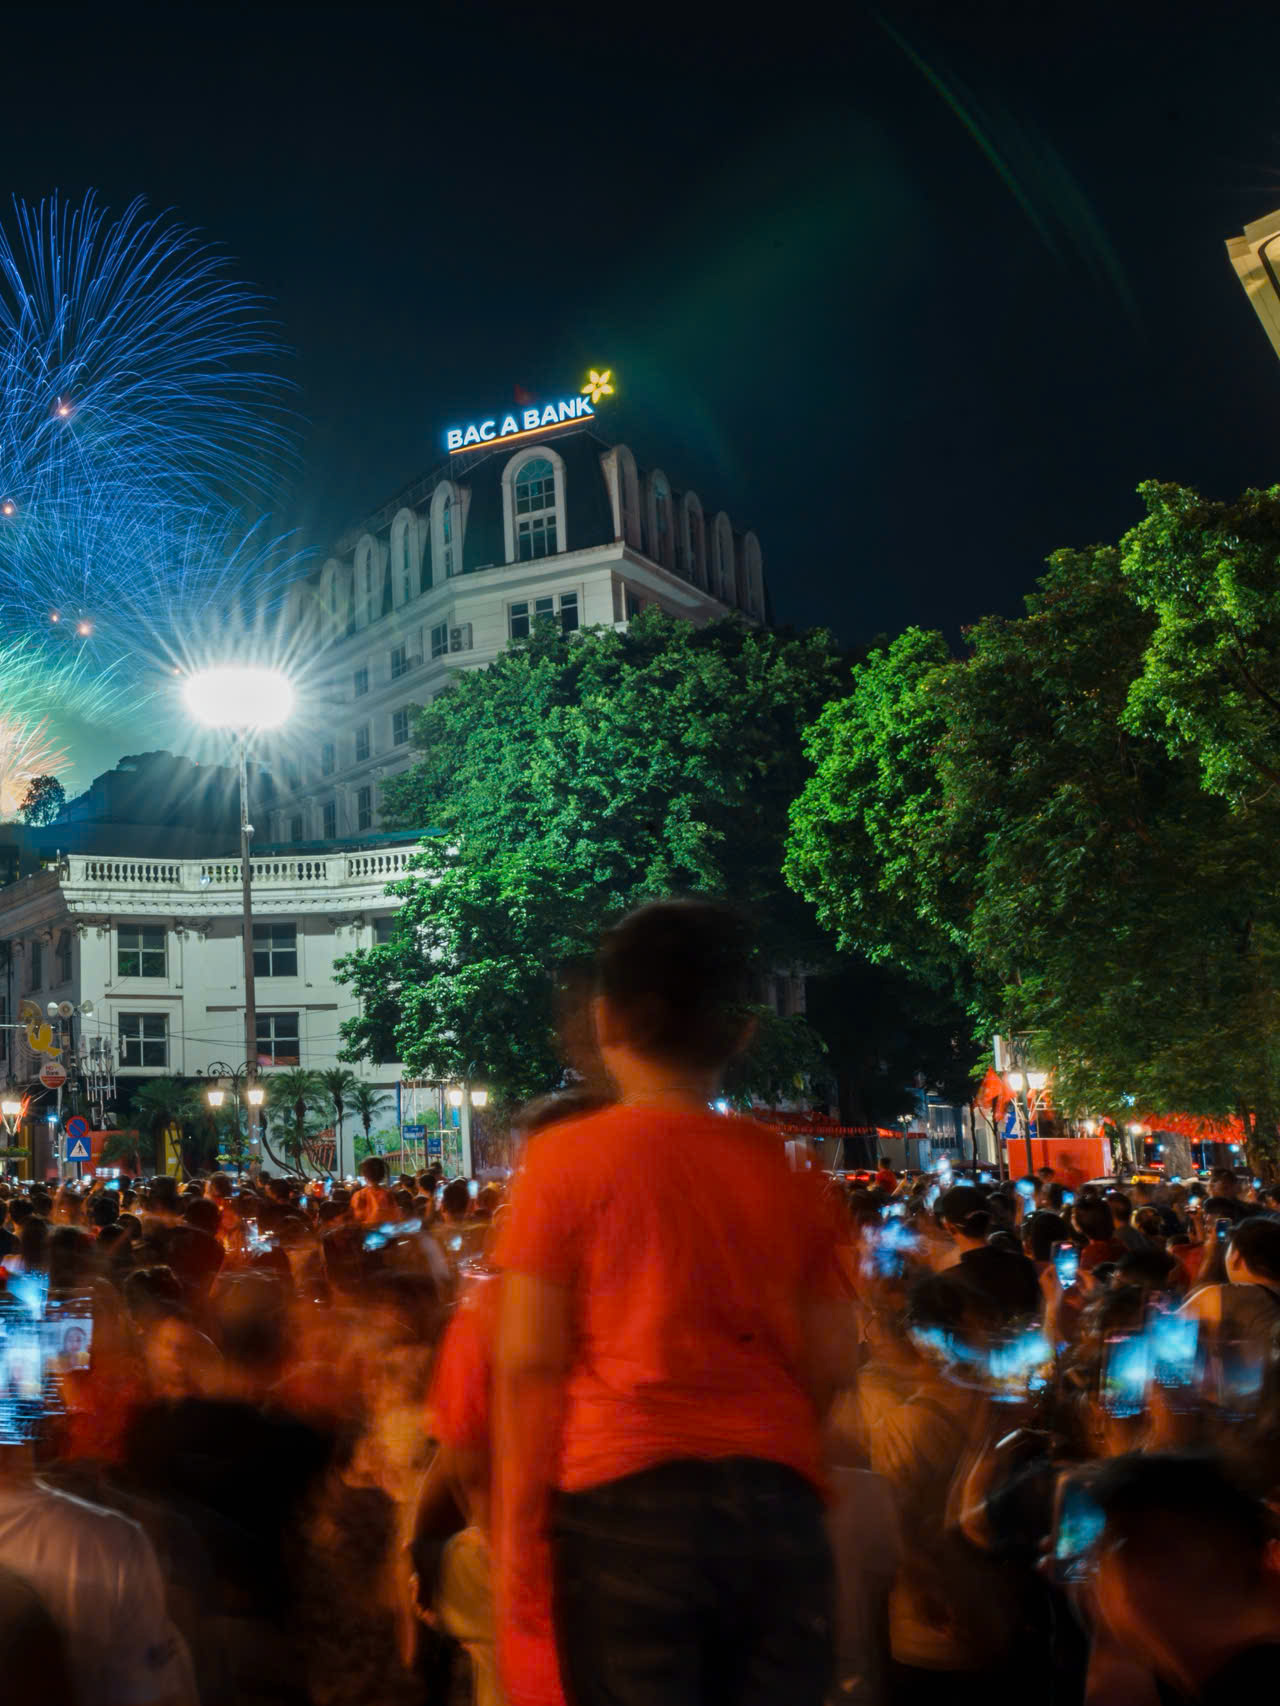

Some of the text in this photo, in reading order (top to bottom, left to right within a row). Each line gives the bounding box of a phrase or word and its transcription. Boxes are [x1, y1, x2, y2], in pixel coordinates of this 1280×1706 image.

[447, 396, 593, 450] BAC A BANK
